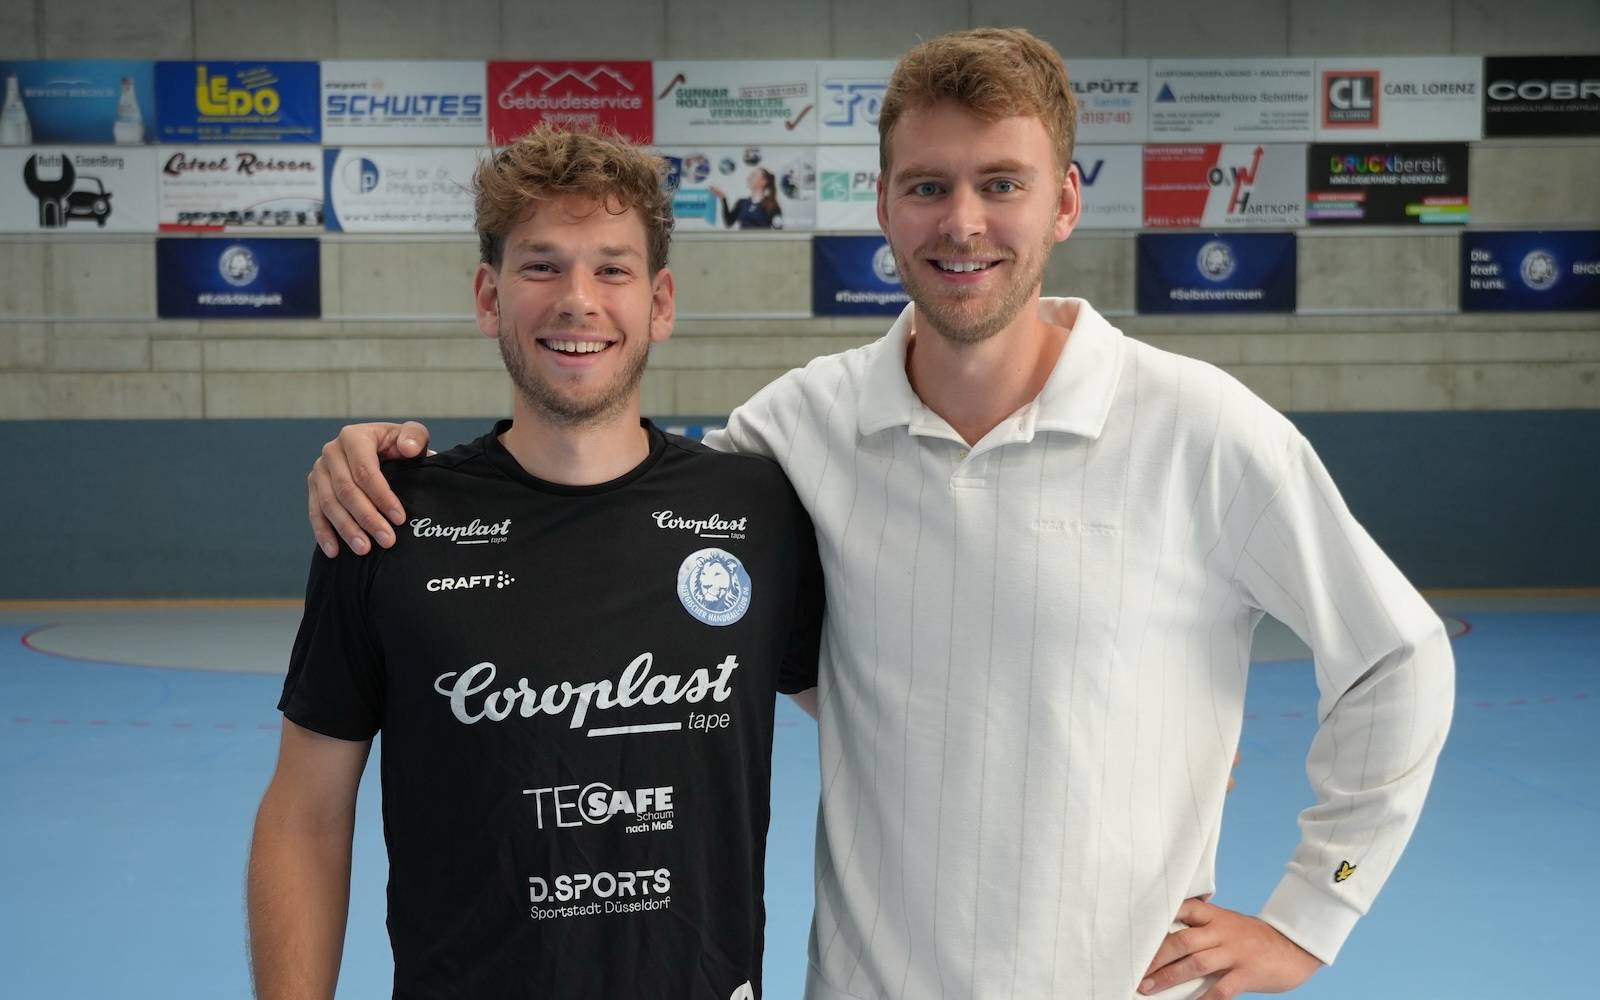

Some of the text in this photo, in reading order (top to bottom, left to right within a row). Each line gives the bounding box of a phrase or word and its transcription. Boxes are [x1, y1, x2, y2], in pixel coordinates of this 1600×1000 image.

[196, 64, 280, 116] LEDO
[675, 87, 729, 98] GUNNAR
[1329, 79, 1372, 110] CL
[1384, 82, 1475, 96] CARL LORENZ
[326, 95, 483, 116] SCHULTES
[497, 90, 642, 110] Gebäudeservice
[708, 97, 784, 109] IMMOBILIEN
[709, 108, 792, 119] VERWALTUNG
[235, 152, 316, 176] Reisen
[1470, 250, 1490, 262] Die
[1470, 264, 1499, 276] Kraft
[1169, 288, 1264, 300] #Selbstvertrauen
[410, 517, 512, 541] Coroplast
[652, 510, 748, 534] Coroplast
[490, 536, 508, 544] tape
[730, 532, 746, 540] tape
[426, 575, 495, 592] CRAFT
[434, 652, 739, 728] Coroplast
[688, 711, 730, 732] tape
[636, 811, 674, 822] Schaum
[625, 820, 674, 834] nach Maß
[528, 868, 671, 903] D.SPORTS
[530, 896, 671, 921] Sportstadt Düsseldorf
